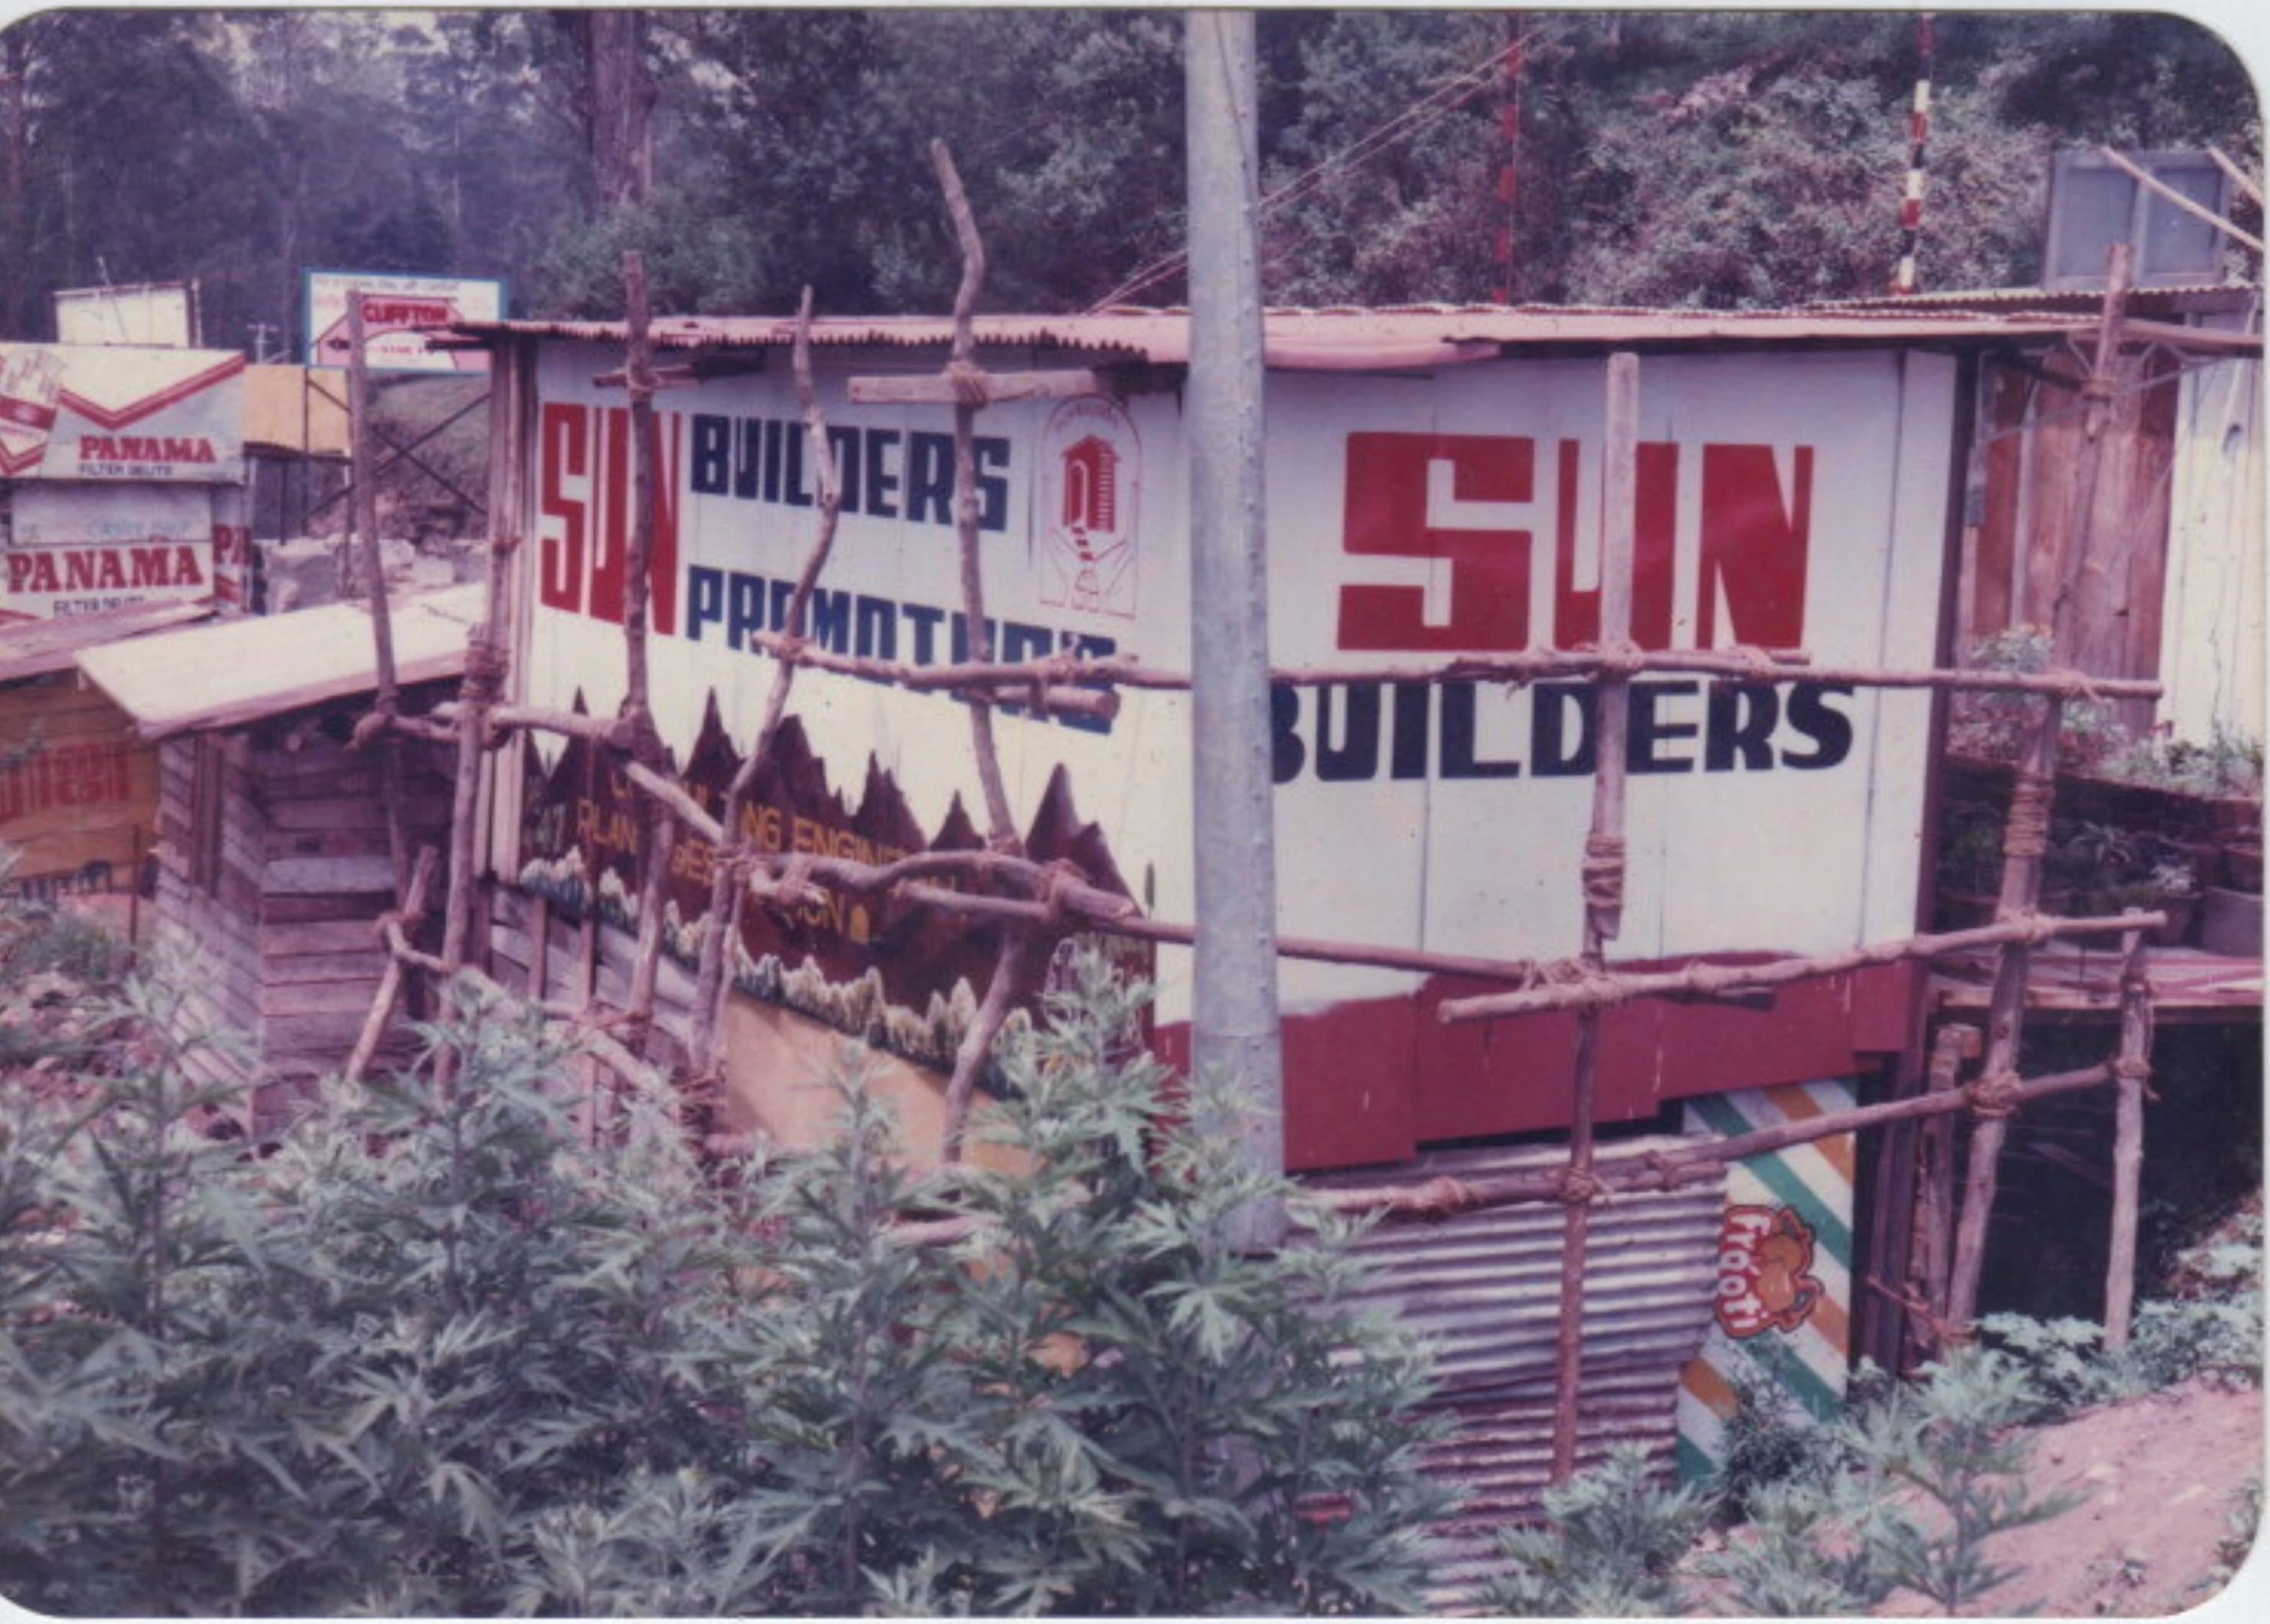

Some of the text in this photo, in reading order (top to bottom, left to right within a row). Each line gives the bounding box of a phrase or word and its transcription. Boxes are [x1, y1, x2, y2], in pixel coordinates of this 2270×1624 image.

[79, 435, 216, 463] PANAMA
[691, 413, 1010, 532] BUILDERS
[7, 545, 204, 594] PANAMA
[541, 402, 680, 635] SUN
[1337, 432, 1814, 652] SUN
[1270, 678, 1854, 785] BUILDERS
[1718, 1214, 1771, 1328] Frooti
